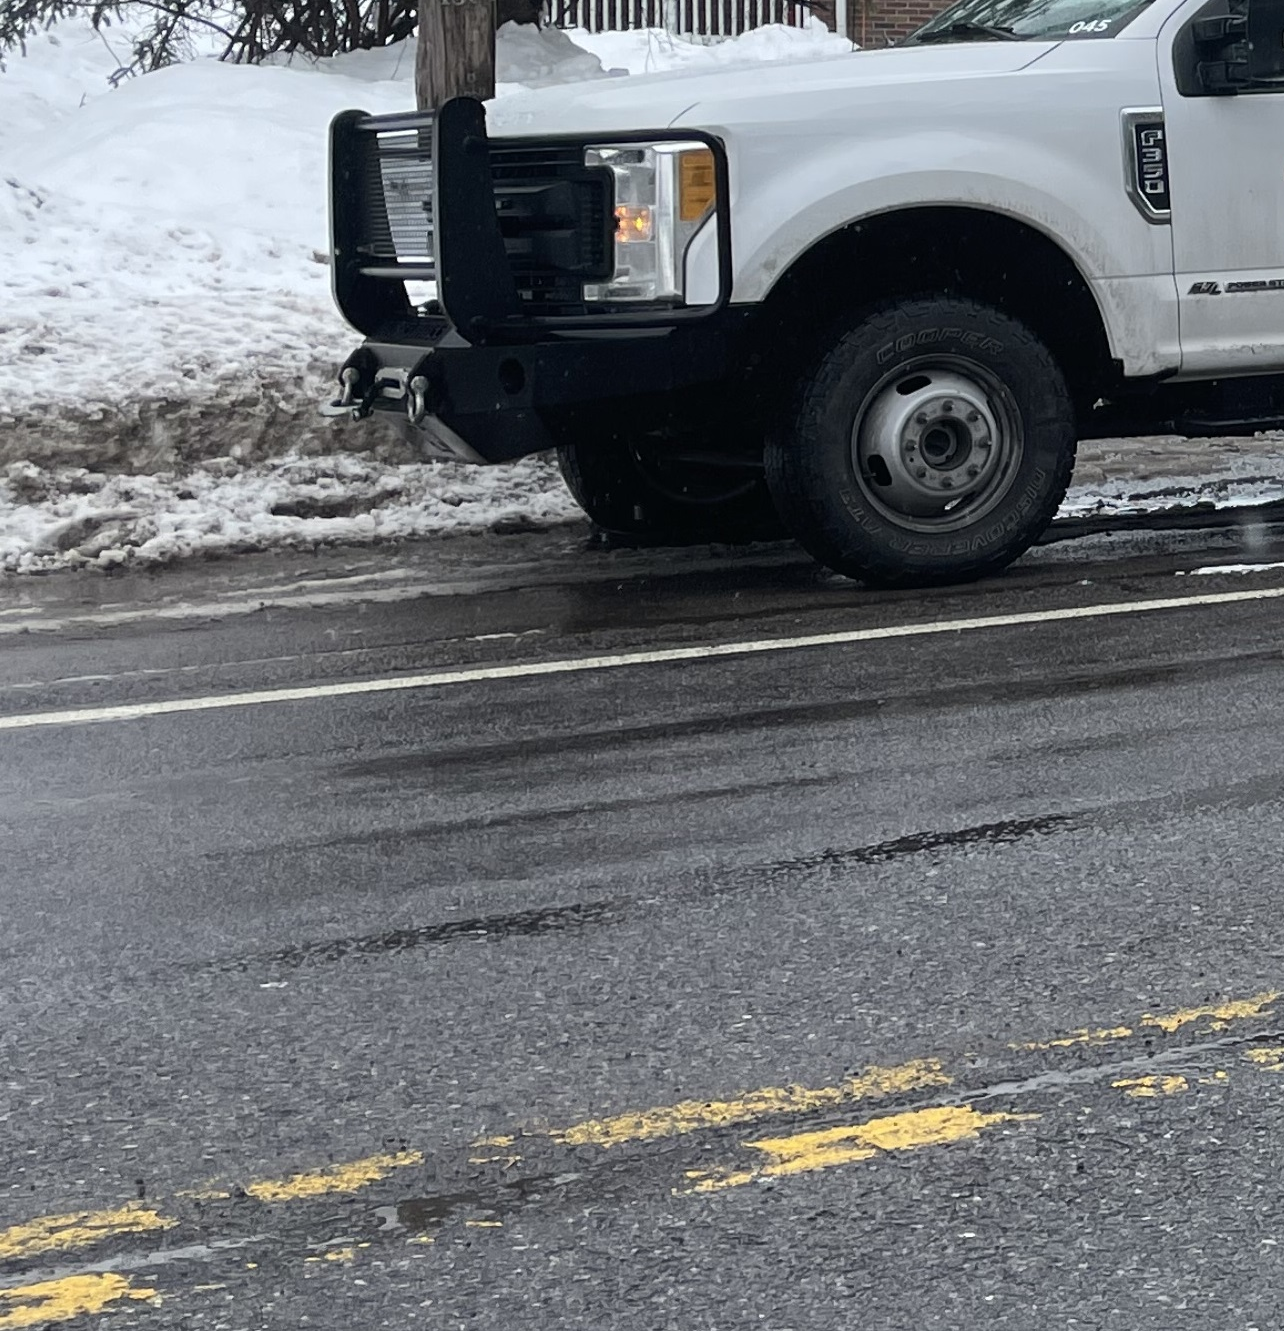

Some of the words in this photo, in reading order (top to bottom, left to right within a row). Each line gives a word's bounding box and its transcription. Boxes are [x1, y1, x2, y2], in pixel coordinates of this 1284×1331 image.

[1069, 19, 1112, 34] 045
[1140, 129, 1165, 194] F350
[876, 327, 1004, 365] COOPER
